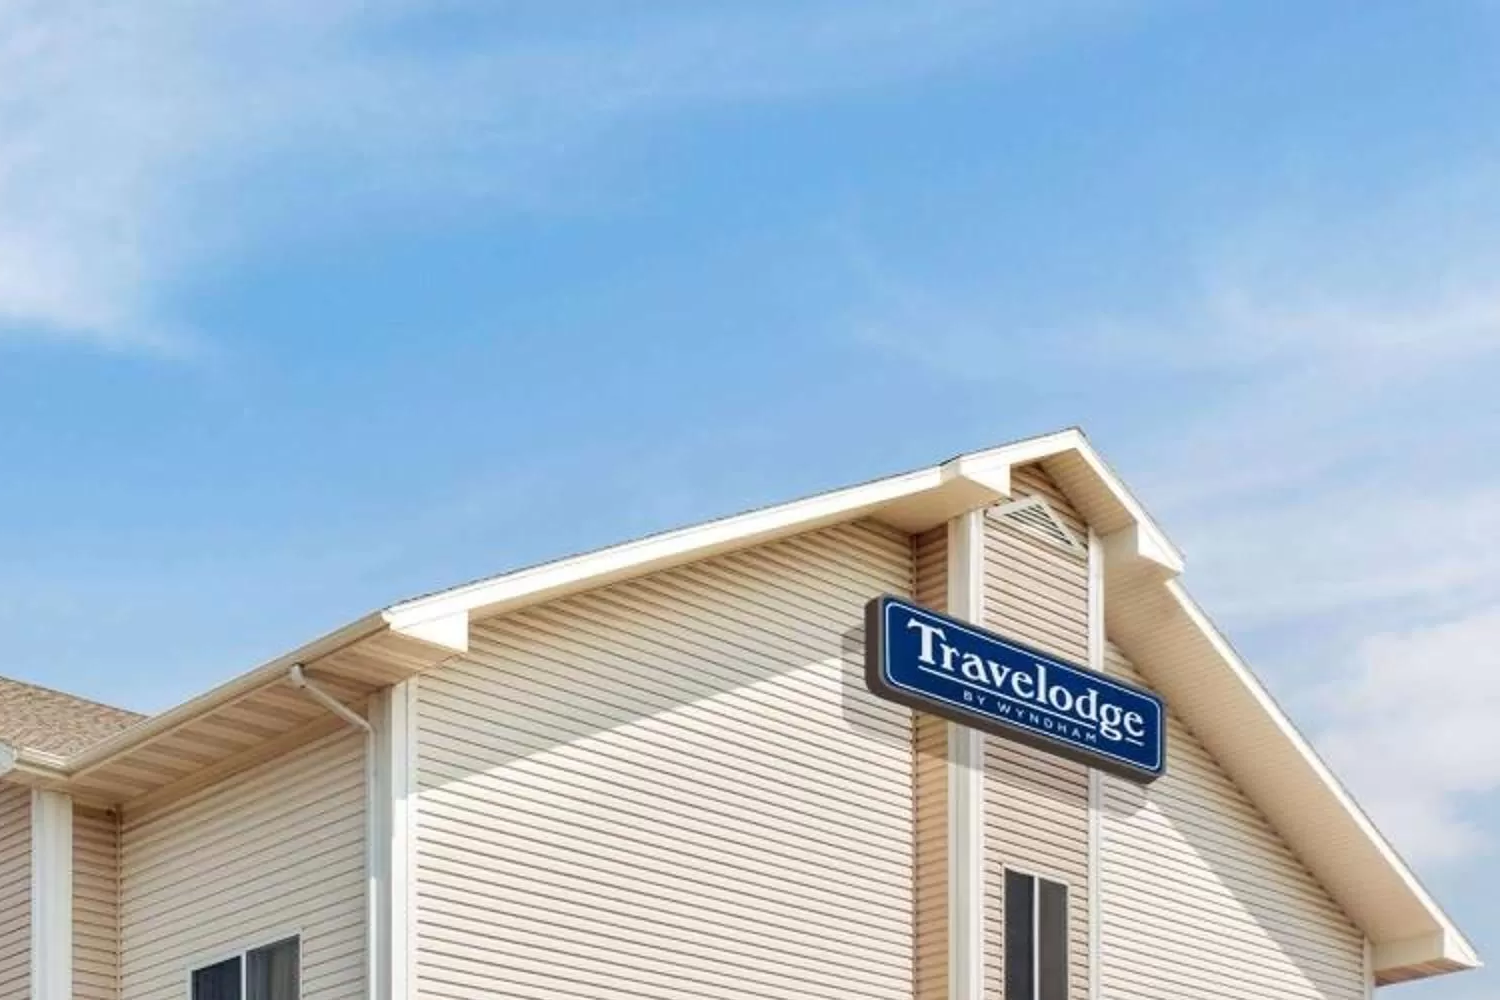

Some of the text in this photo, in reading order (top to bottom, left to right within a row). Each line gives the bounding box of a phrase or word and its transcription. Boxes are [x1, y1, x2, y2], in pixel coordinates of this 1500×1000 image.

[907, 618, 1145, 742] Travelodge
[963, 690, 1098, 744] BY WYNDHAM
